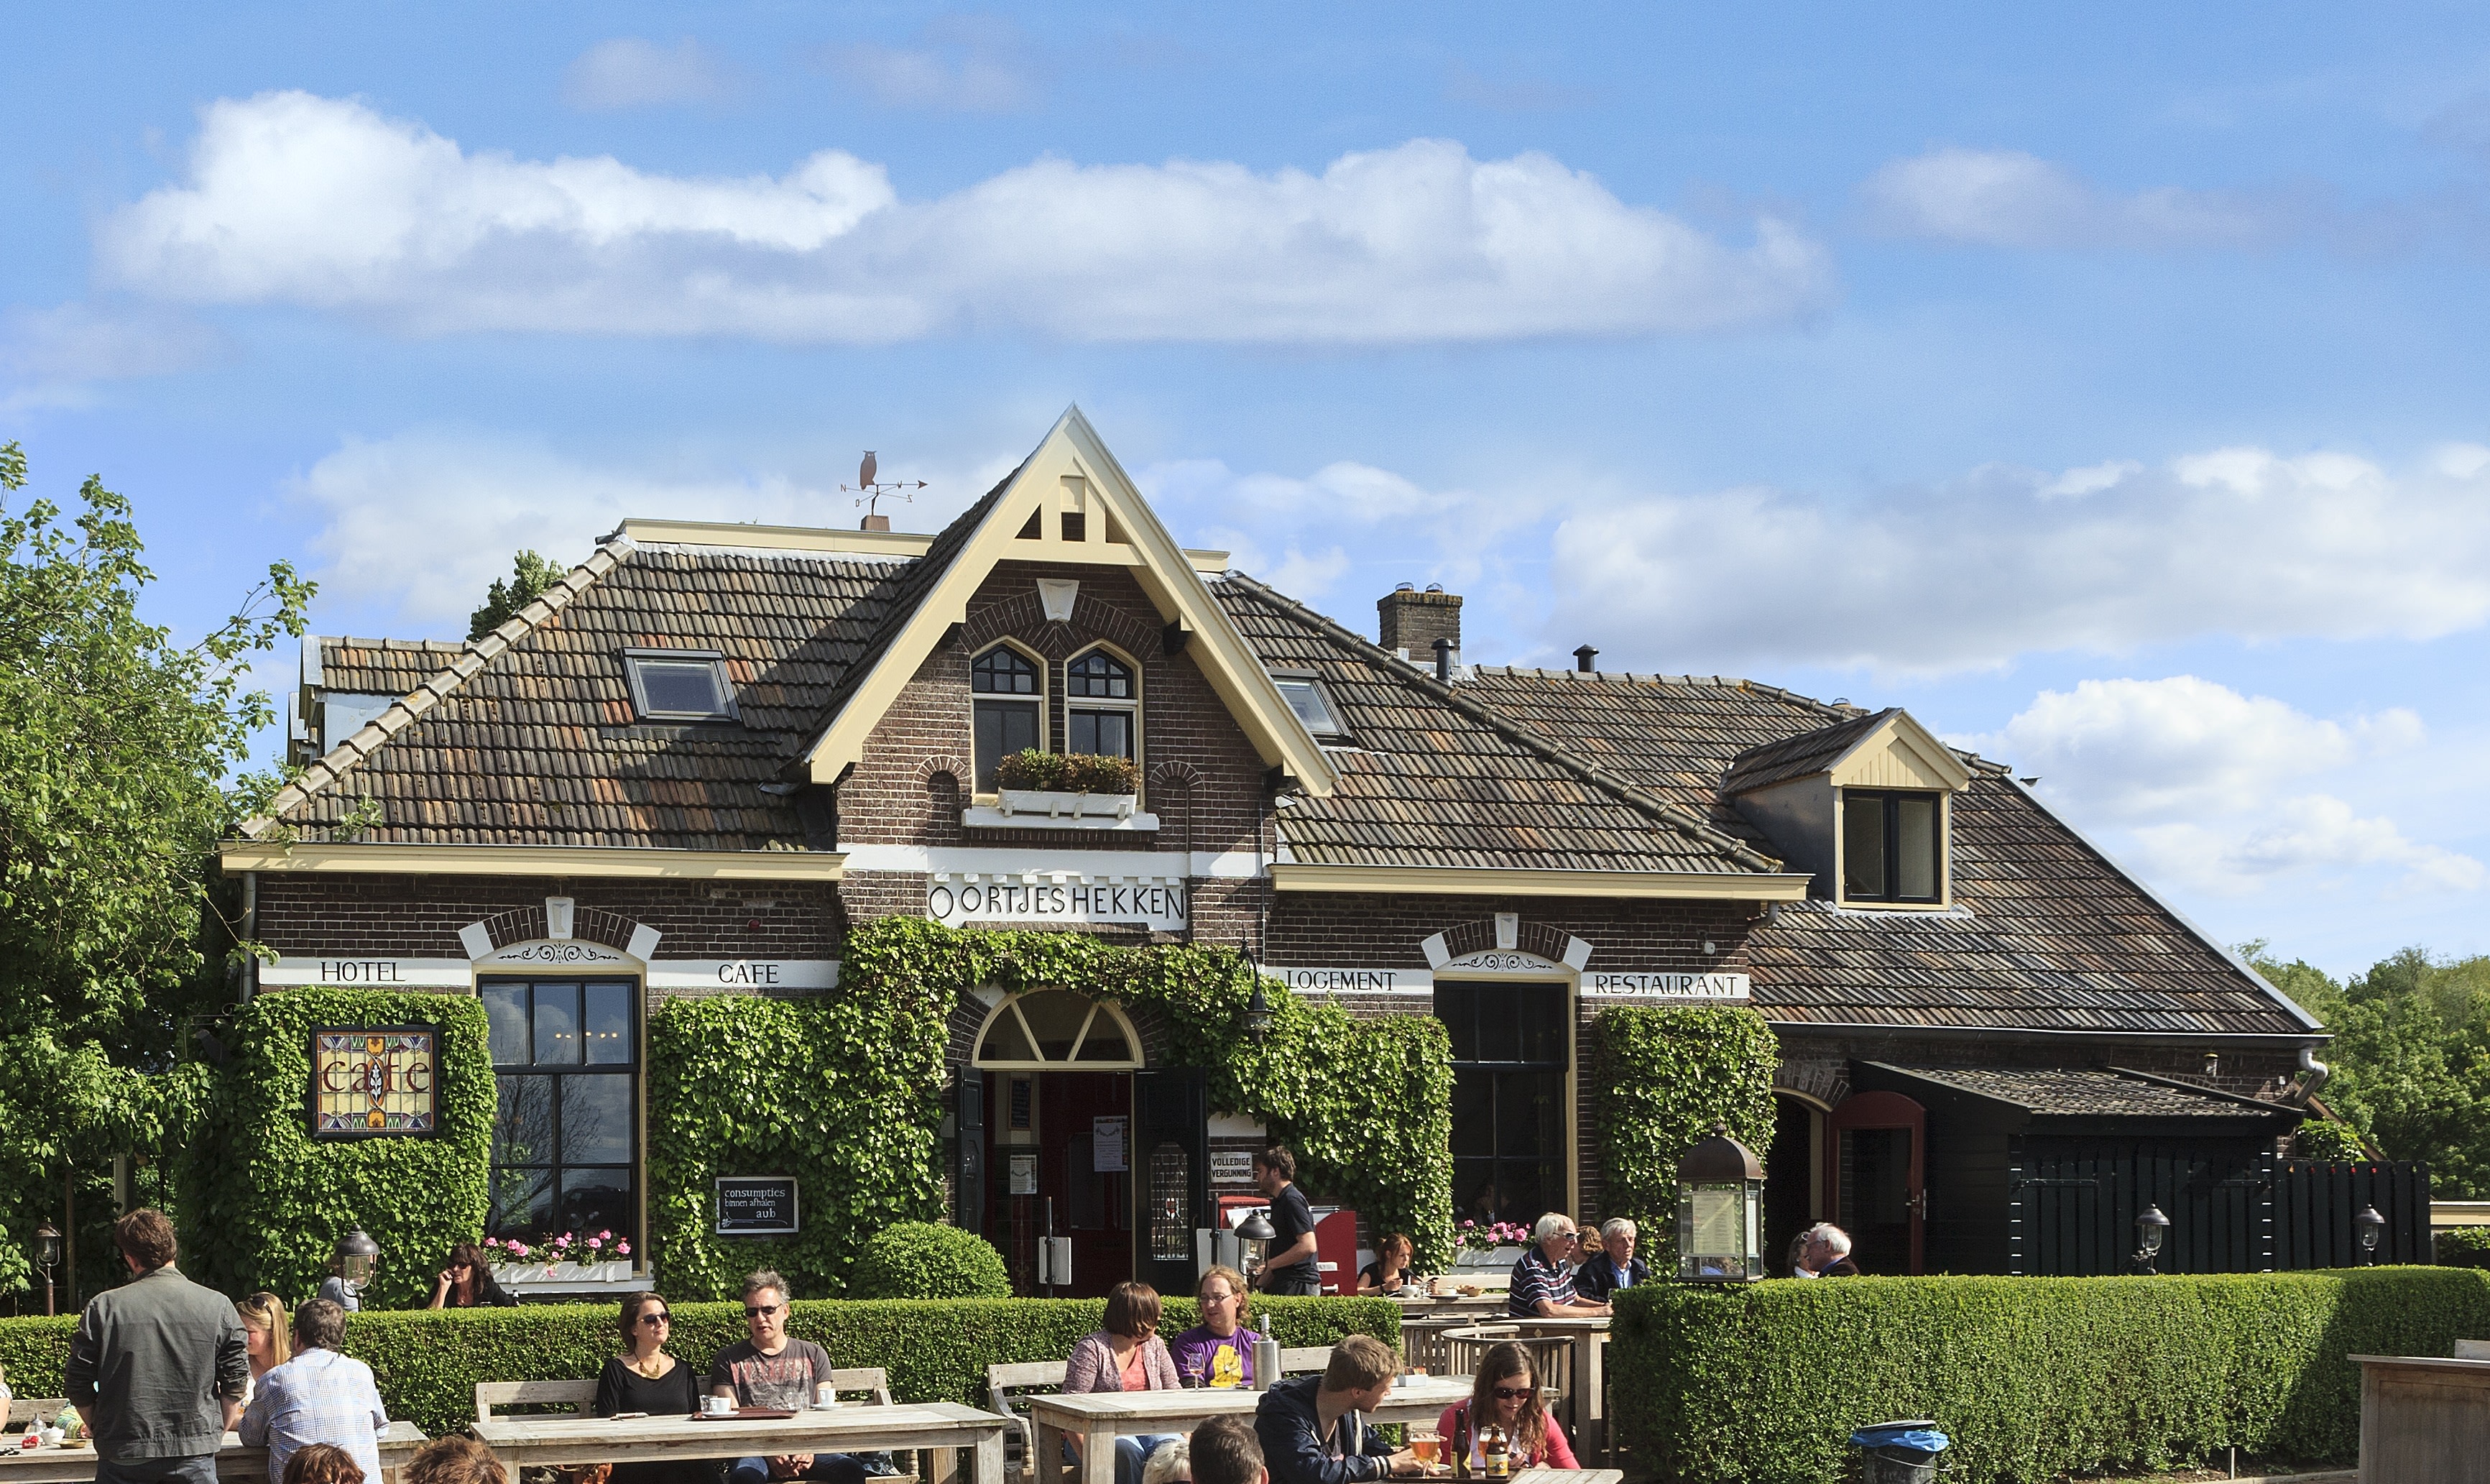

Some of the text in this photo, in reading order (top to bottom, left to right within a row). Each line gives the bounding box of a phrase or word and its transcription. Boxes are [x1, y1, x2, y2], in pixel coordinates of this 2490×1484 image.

[840, 483, 847, 492] N
[928, 885, 1186, 919] OORTJESHEKKEN
[321, 961, 408, 982] HOTEL
[718, 964, 780, 983] CAFE
[1286, 970, 1398, 991] LOGEMENT
[1594, 974, 1738, 996] RESTAURANT
[323, 1044, 430, 1093] cafe
[1212, 1158, 1251, 1166] VOLLEDIGE
[1211, 1169, 1252, 1178] VERGUNNING
[724, 1187, 785, 1200] consumpties
[724, 1197, 775, 1207] binnen afhalen
[756, 1207, 776, 1219] aub
